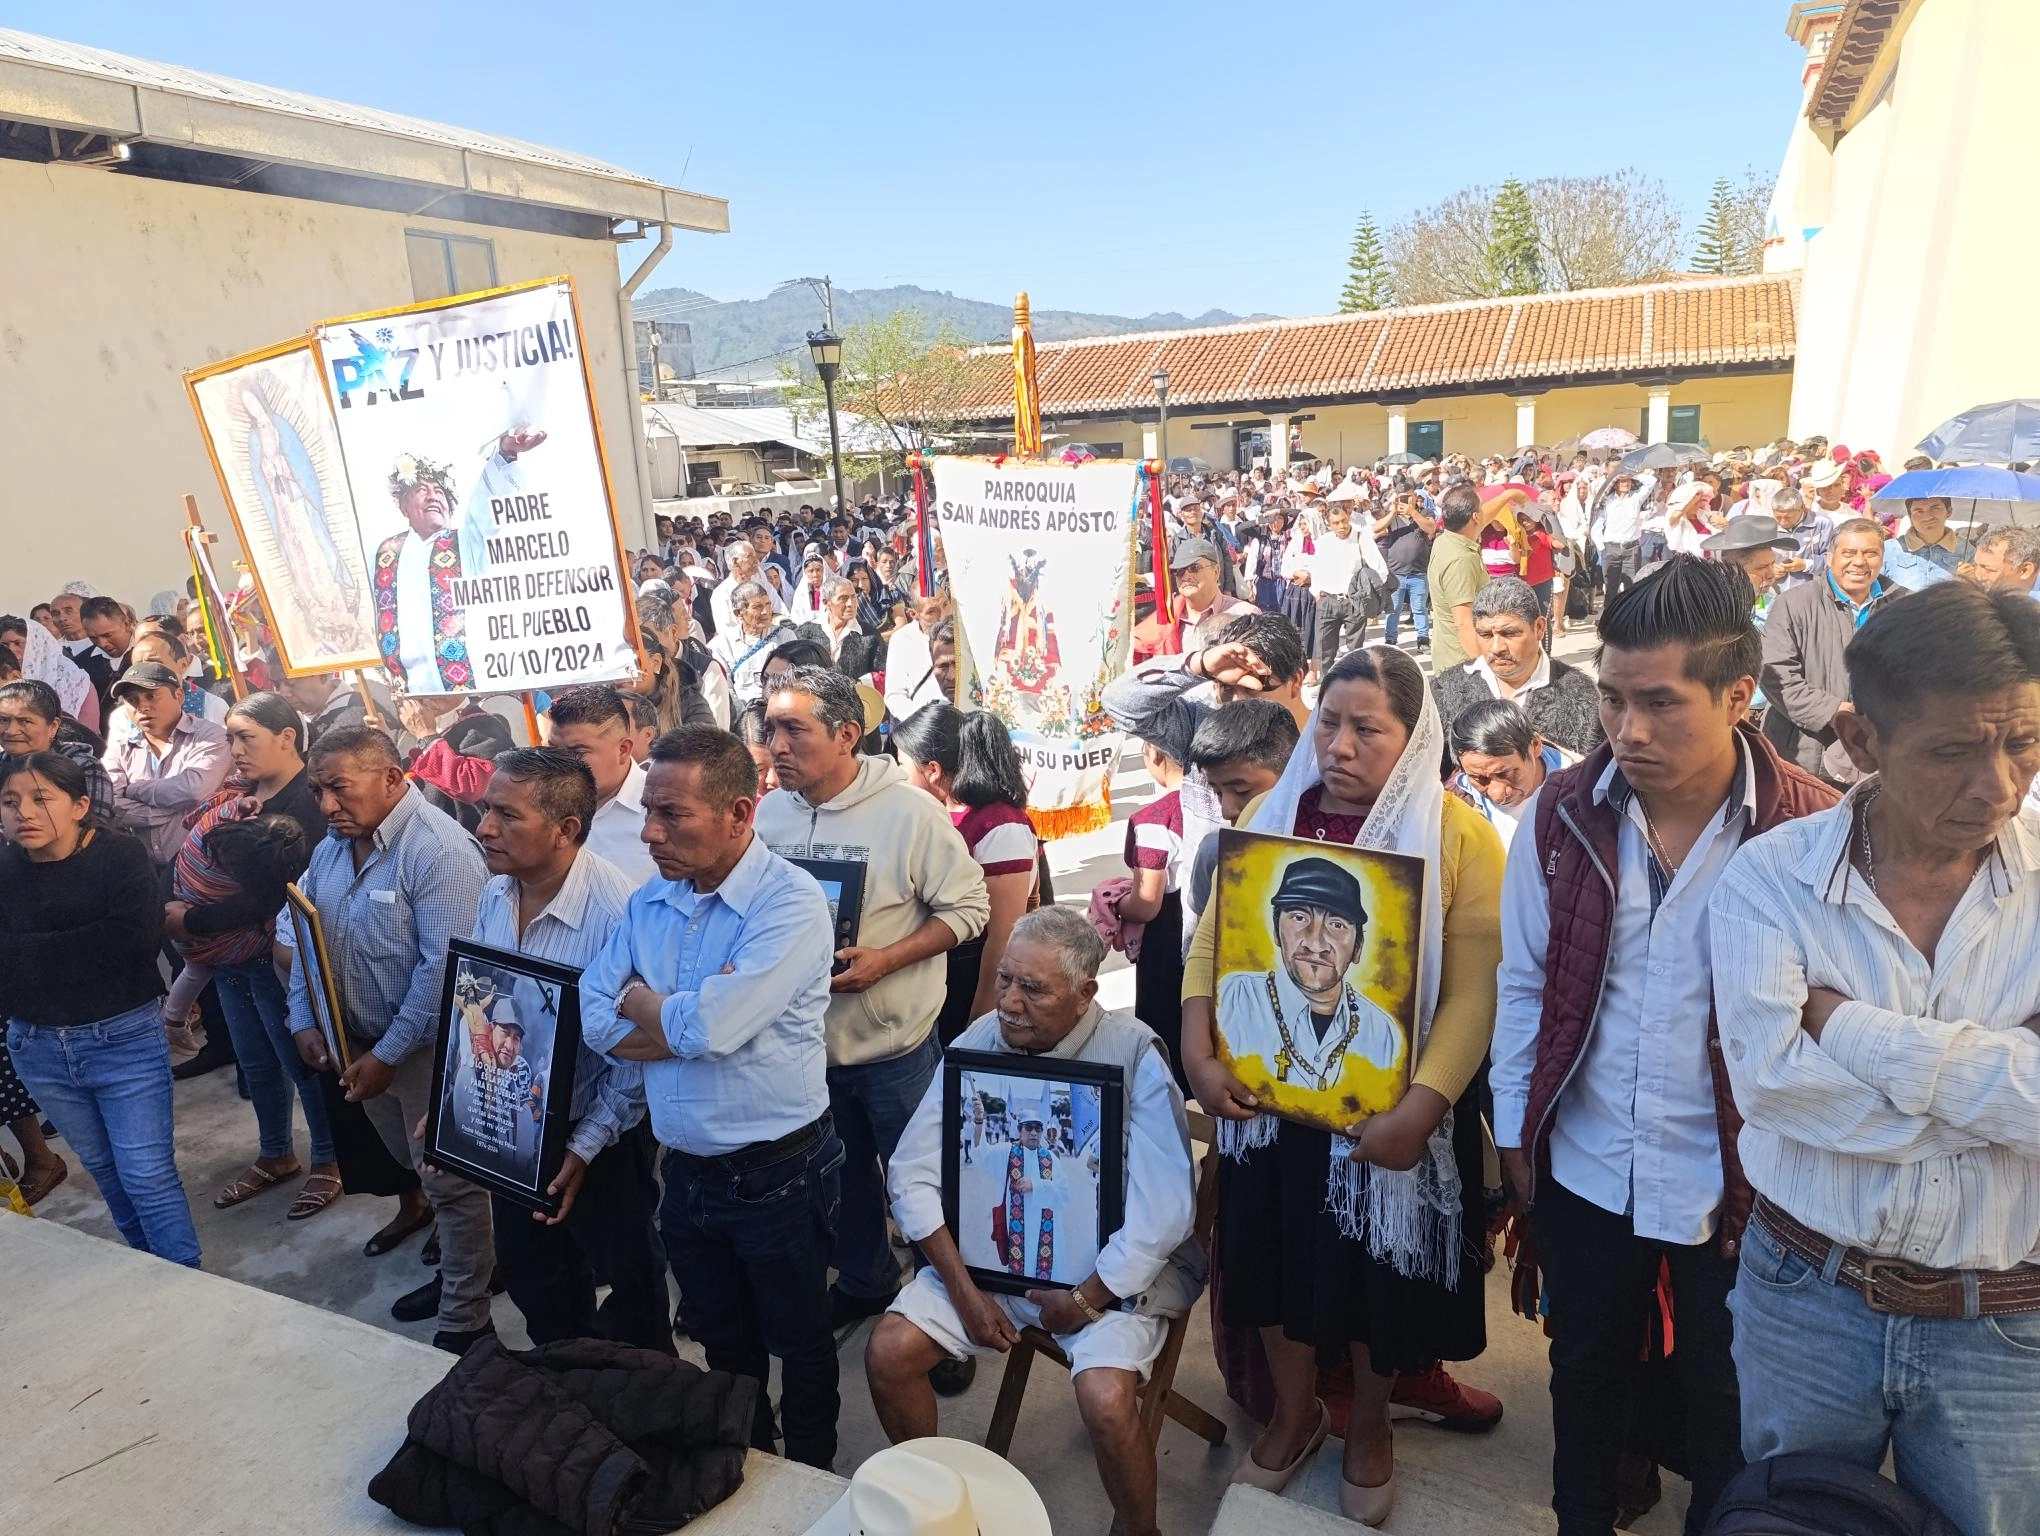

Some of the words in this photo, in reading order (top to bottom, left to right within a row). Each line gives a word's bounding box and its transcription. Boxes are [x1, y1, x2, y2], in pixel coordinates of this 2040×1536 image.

[427, 342, 444, 381] Y
[454, 318, 574, 378] JUSTICIA!
[984, 480, 1076, 504] PARROQUIA
[491, 493, 552, 525] PADRE
[942, 501, 973, 525] SAN
[979, 505, 1041, 531] ANDRÉS
[487, 530, 570, 565] MARCELO
[453, 576, 522, 606] MARTIR
[525, 565, 614, 600] DEFENSOR
[488, 613, 519, 641] DEL
[523, 606, 592, 637] PUEBLO
[484, 642, 604, 679] 20/10/2024
[1036, 750, 1056, 770] SU
[470, 1079, 486, 1090] PARA
[486, 1083, 493, 1092] EL
[483, 1063, 497, 1074] QUE
[497, 1068, 517, 1081] BUSCO
